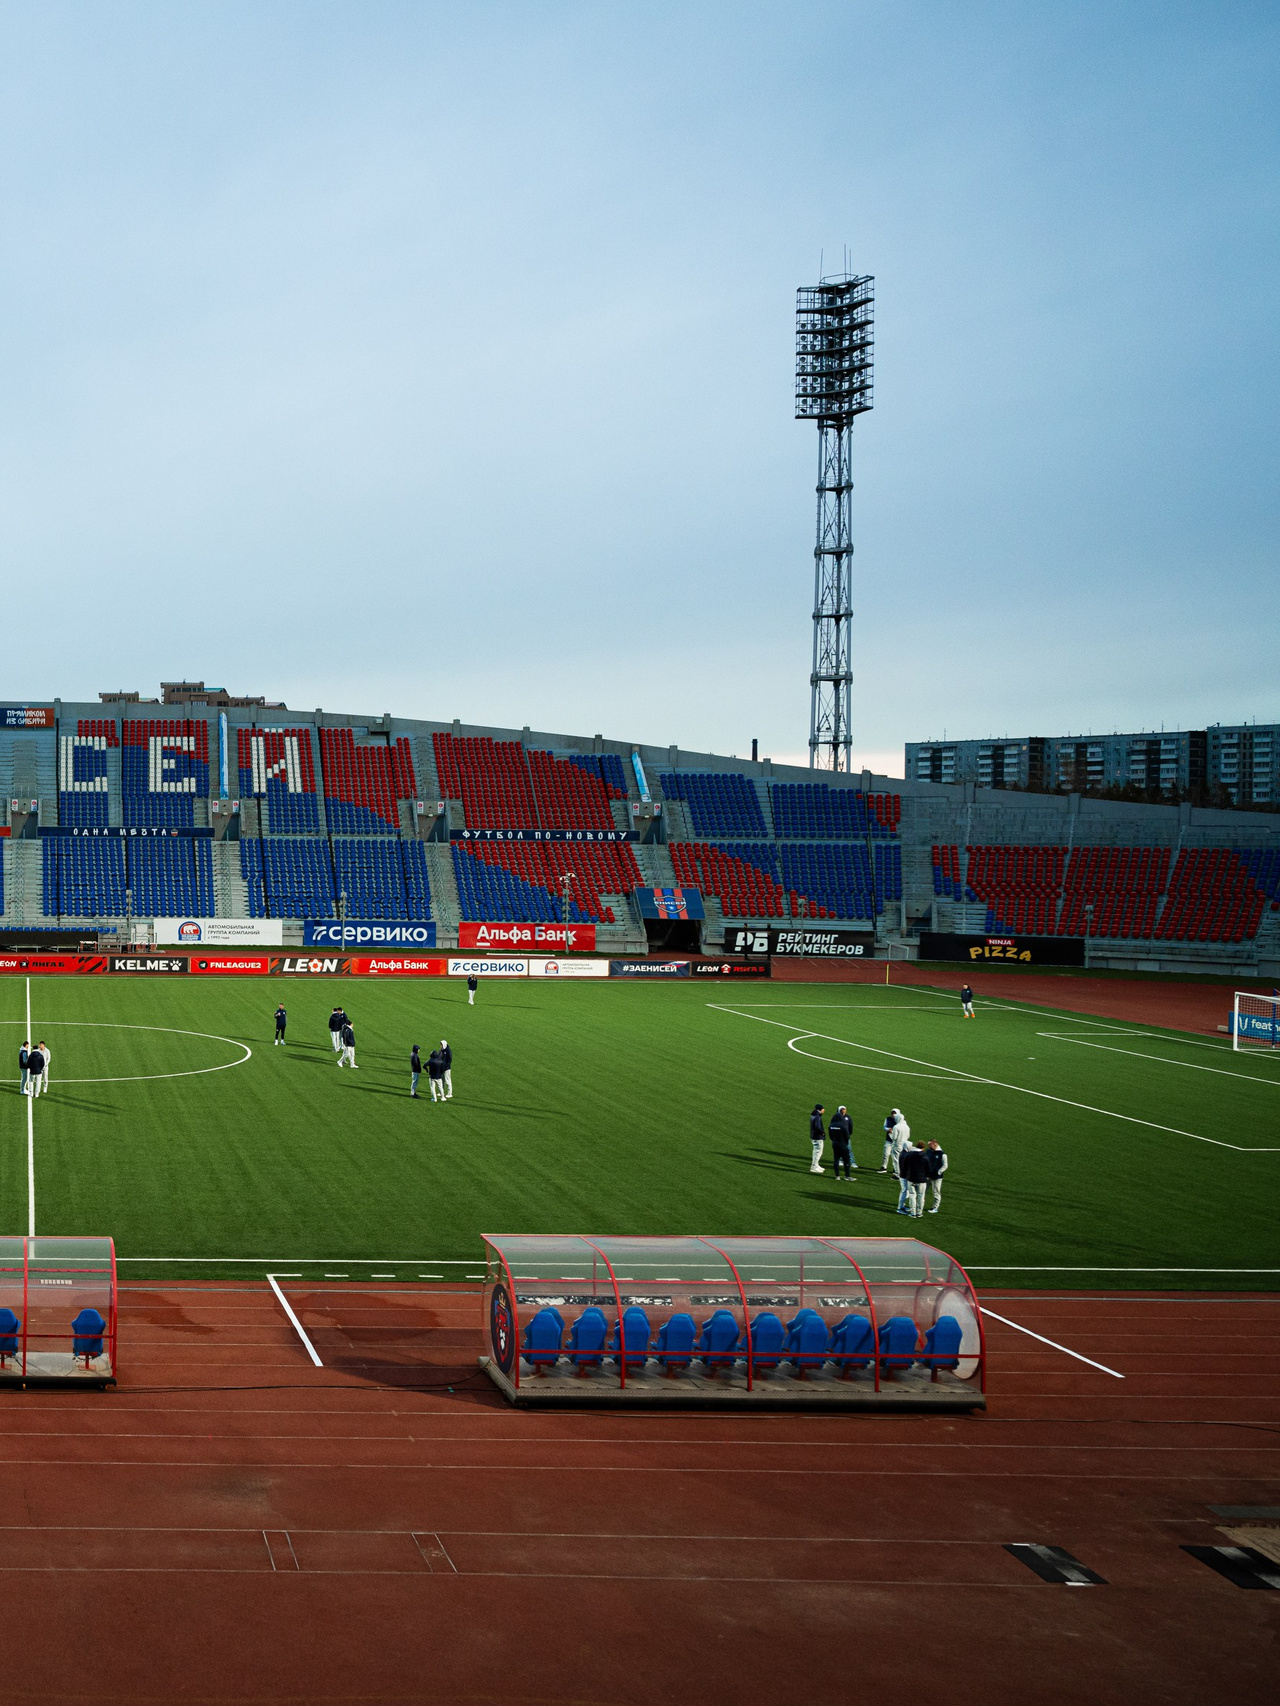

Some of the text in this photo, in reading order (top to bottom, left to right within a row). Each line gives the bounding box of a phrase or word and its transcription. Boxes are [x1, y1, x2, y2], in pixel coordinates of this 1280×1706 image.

[73, 828, 108, 836] ОДНА
[462, 830, 627, 840] ФУТБОЛ ПО-НОВОМУ
[328, 925, 428, 942] сервико
[476, 925, 577, 943] Альфа Банк
[778, 931, 838, 944] РЕЙТИНГ
[776, 943, 864, 955] БУКМЕКЕРОВ
[969, 946, 1032, 961] PIZZA
[115, 959, 169, 971] KELME
[210, 961, 262, 969] FNLEAGUE2
[282, 958, 338, 972] LEON
[369, 959, 429, 970] Альфа Банк
[462, 961, 524, 973] сервико
[622, 964, 677, 972] #ЗАЕНИСЕЙ
